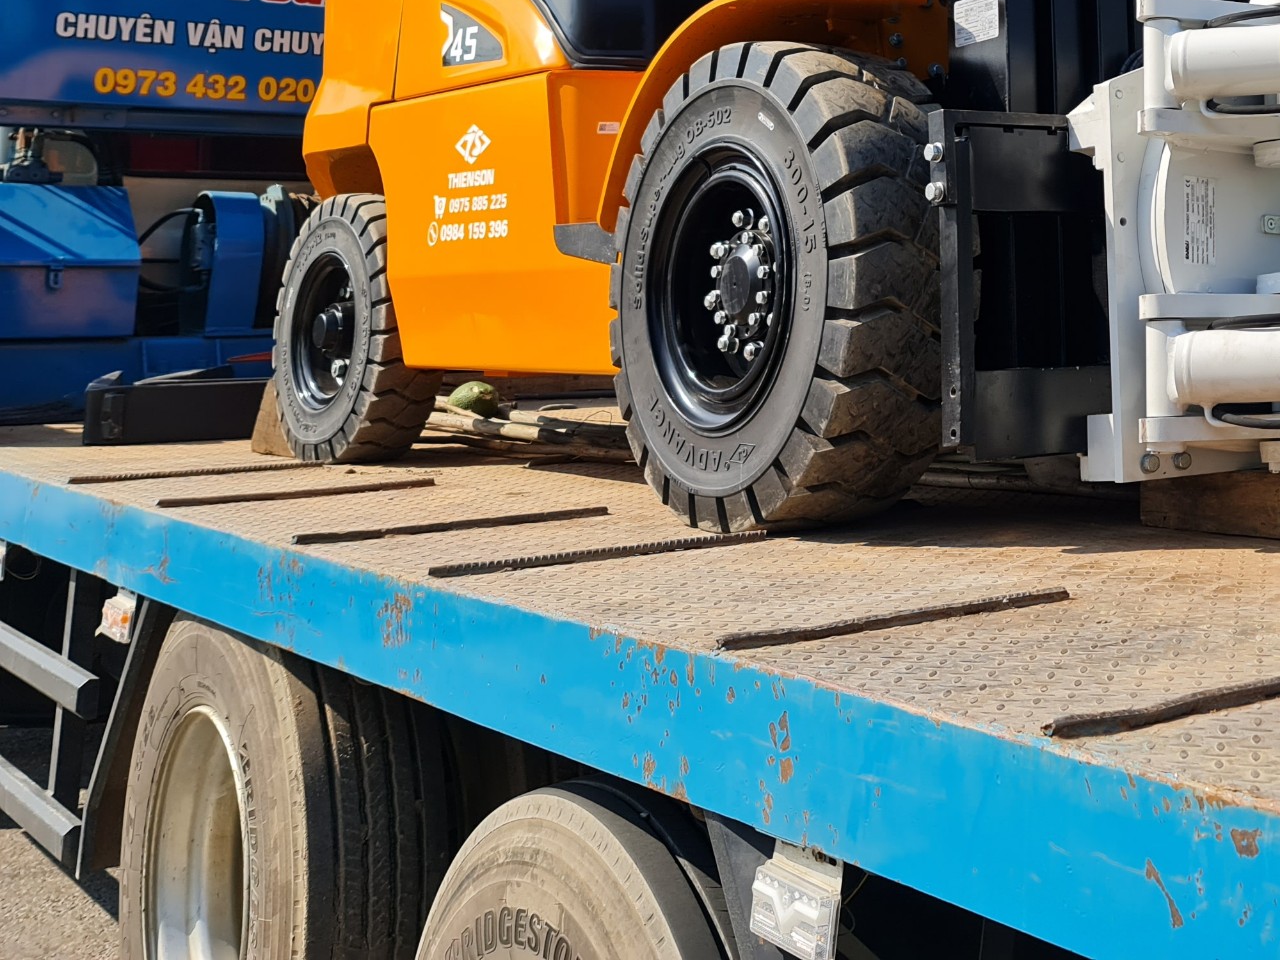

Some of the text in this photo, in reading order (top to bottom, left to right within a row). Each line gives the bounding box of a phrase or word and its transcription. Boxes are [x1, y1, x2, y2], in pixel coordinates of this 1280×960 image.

[55, 12, 324, 55] CHUYÊN VẬN CHUY
[450, 26, 478, 62] 45
[94, 67, 315, 103] 0973 432 020
[686, 106, 732, 144] OB-502
[448, 169, 495, 189] THIENSON
[449, 197, 470, 213] 0975
[490, 193, 507, 209] 225
[784, 146, 817, 254] 300-15
[440, 220, 508, 241] 0984 159 396
[648, 390, 722, 472] ADVANCE
[444, 906, 583, 960] BRIDGESTO
